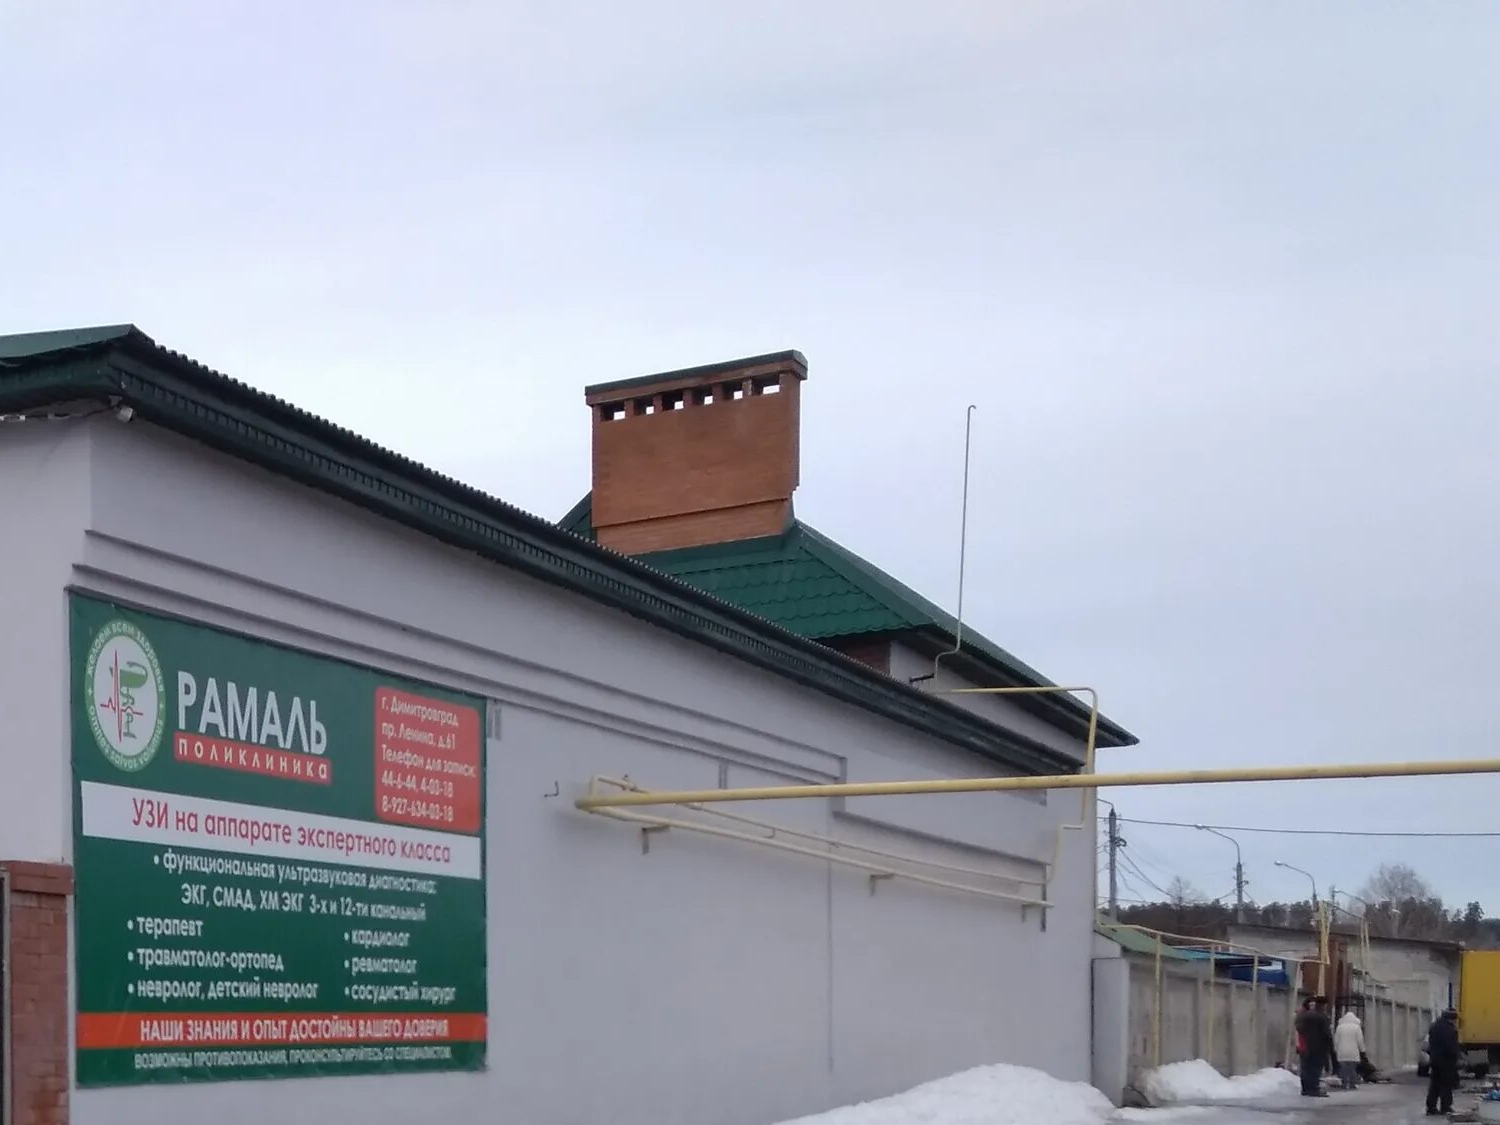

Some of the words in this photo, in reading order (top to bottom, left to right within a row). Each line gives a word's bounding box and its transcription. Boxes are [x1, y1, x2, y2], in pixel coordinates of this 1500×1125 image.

[178, 670, 327, 755] РАМАЛЬ
[382, 744, 424, 768] Телефон
[132, 798, 169, 829] УЗИ
[175, 810, 198, 833] на
[205, 814, 292, 845] аппарате
[298, 827, 396, 857] экспертного
[401, 841, 452, 863] класса
[163, 848, 275, 879] функциональная
[277, 864, 366, 888] ультразвуковая
[181, 883, 210, 907] ЭКГ,
[260, 890, 280, 911] ХМ
[282, 892, 304, 912] ЭКГ
[137, 917, 204, 939] терапевт
[352, 930, 411, 948] кардиолог
[137, 949, 284, 974] травматолог-ортопед
[352, 957, 418, 976] ревматолог
[137, 980, 205, 1003] невролог,
[207, 976, 261, 1000] детский
[263, 982, 318, 1002] невролог
[351, 981, 419, 1004] сосудистый
[420, 987, 456, 1005] хирург
[140, 1020, 184, 1041] НАШИ
[187, 1020, 238, 1041] ЗНАНИЯ
[241, 1020, 250, 1040] И
[253, 1019, 287, 1040] ОПЫТ
[289, 1015, 356, 1041] ДОСТОЙНЫ
[358, 1019, 401, 1038] ВАШЕГО
[403, 1019, 449, 1038] ДОВЕРИЯ
